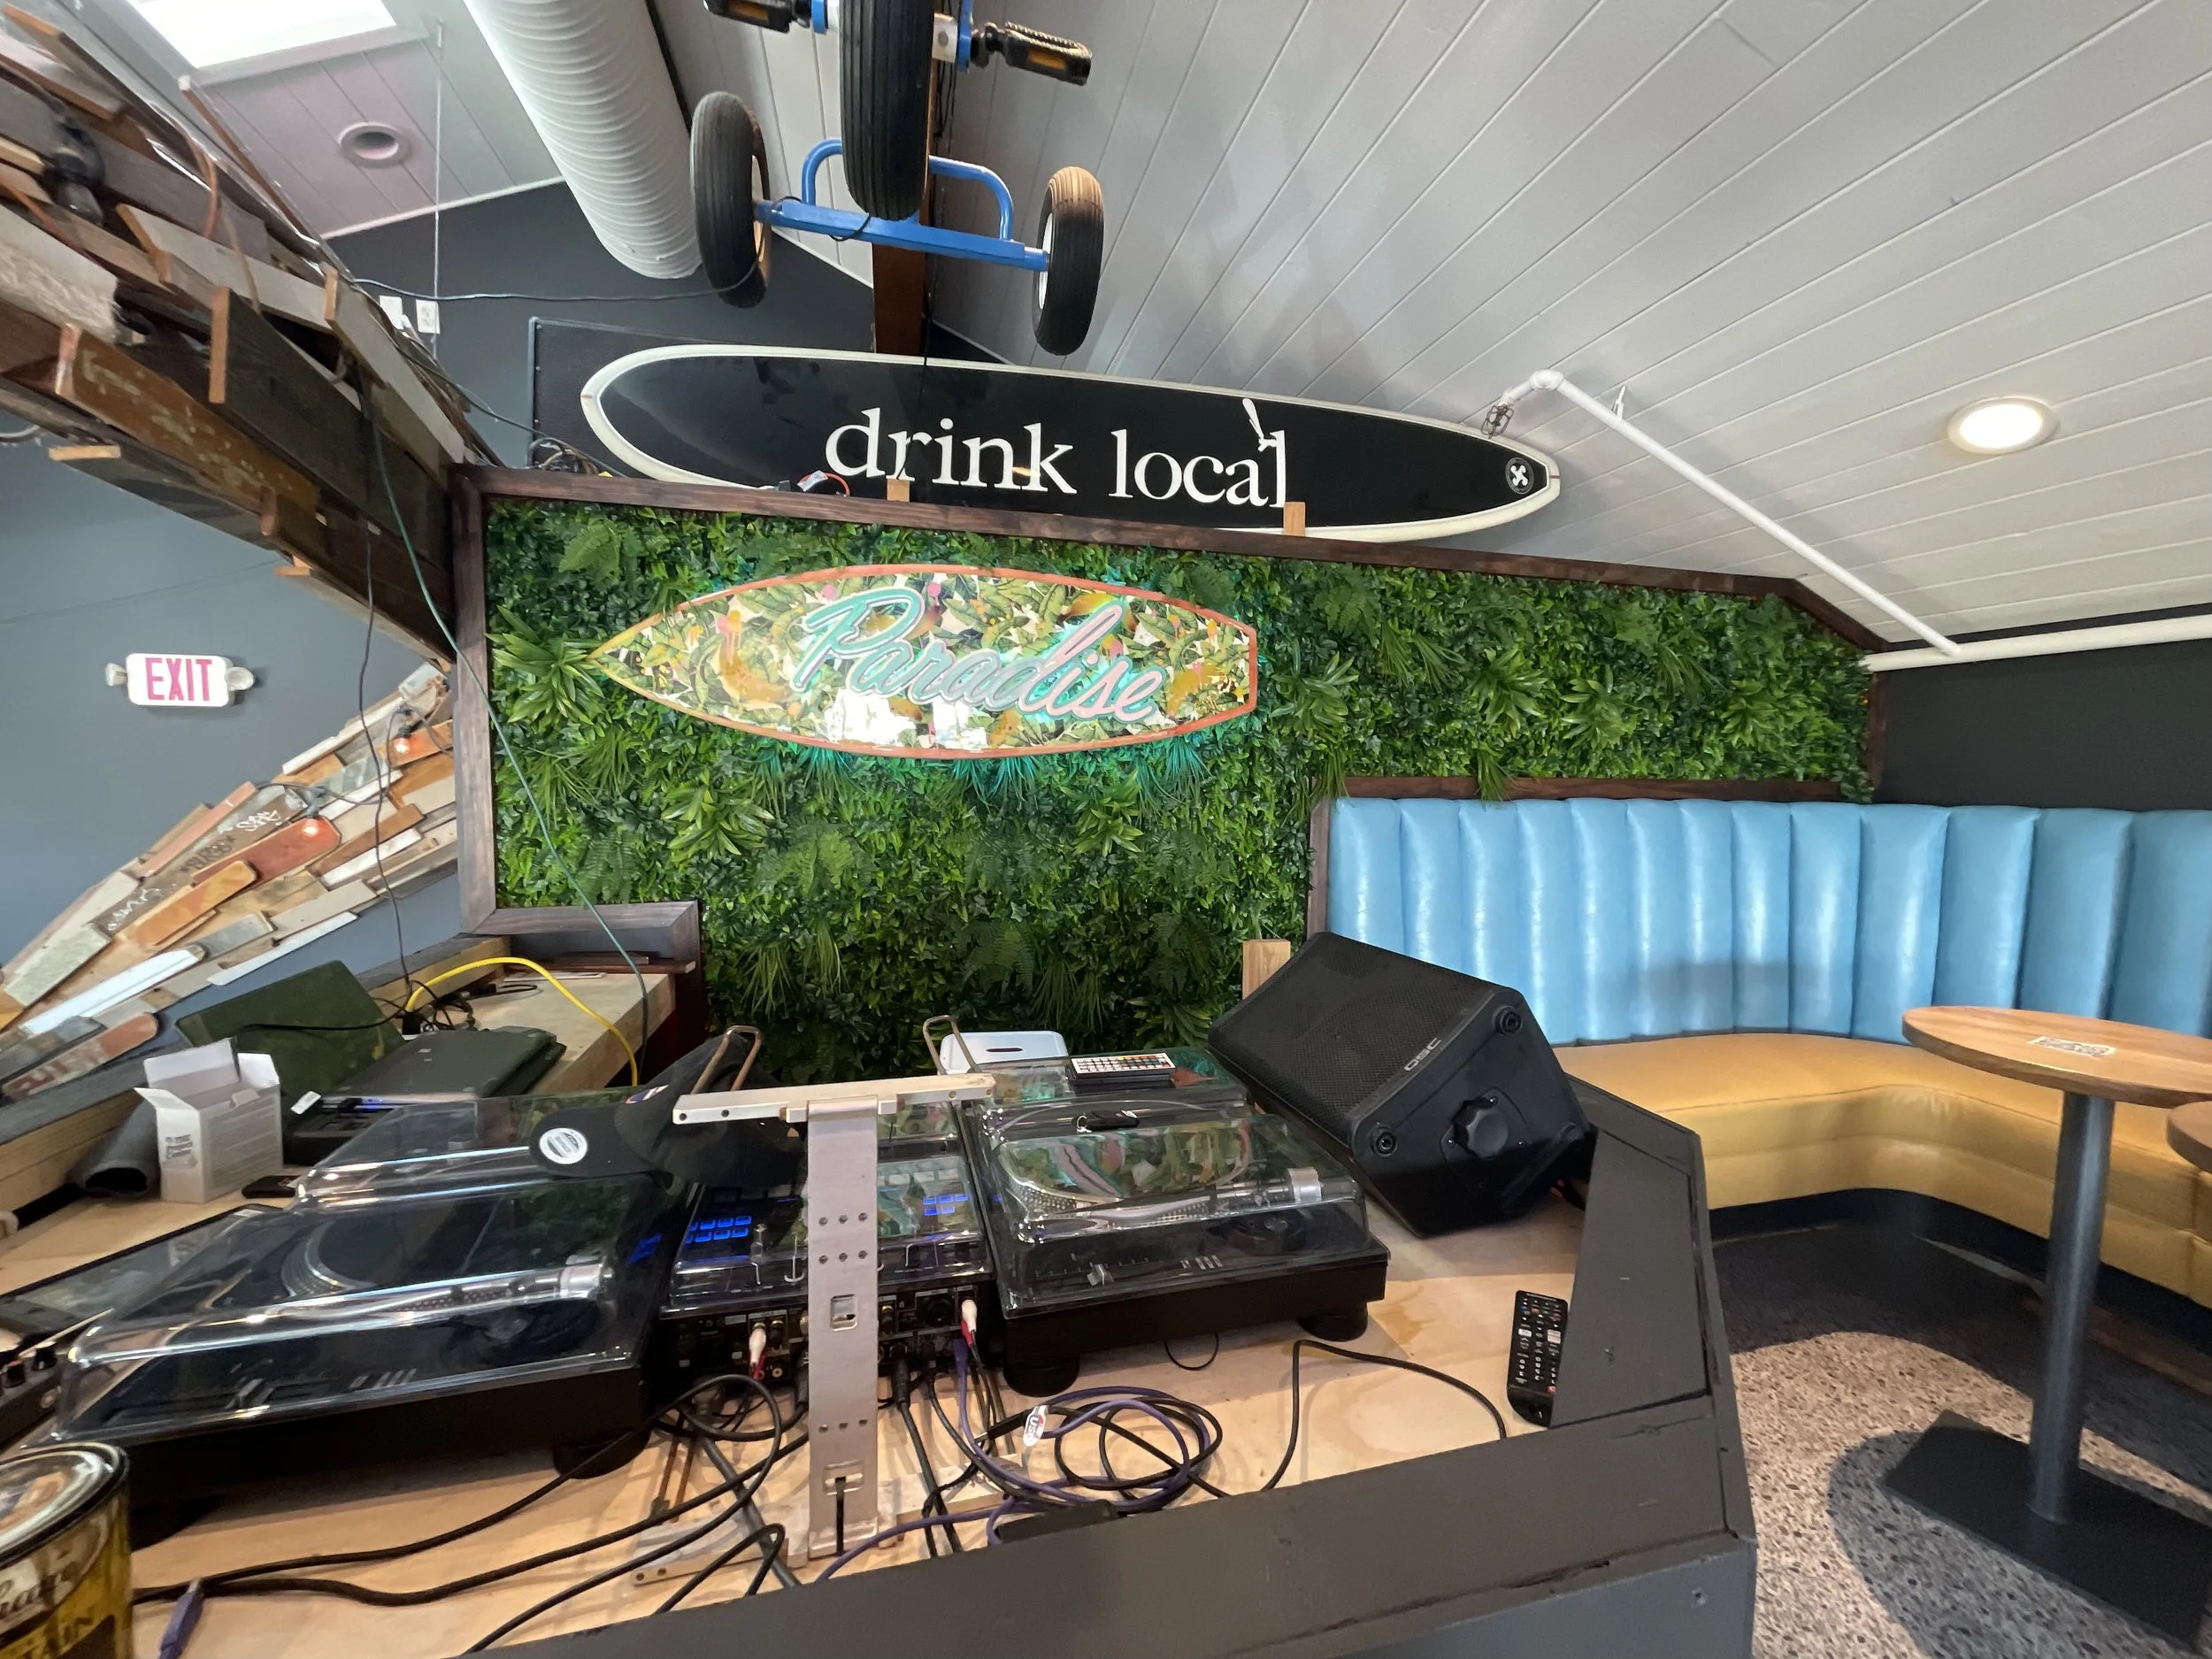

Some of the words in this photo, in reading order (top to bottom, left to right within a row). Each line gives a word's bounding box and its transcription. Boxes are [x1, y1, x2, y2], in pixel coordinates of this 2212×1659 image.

[825, 406, 1077, 495] drink
[1108, 416, 1286, 509] local
[145, 657, 213, 702] EXIT
[791, 585, 1167, 724] Paradise
[1403, 1037, 1442, 1071] QSC
